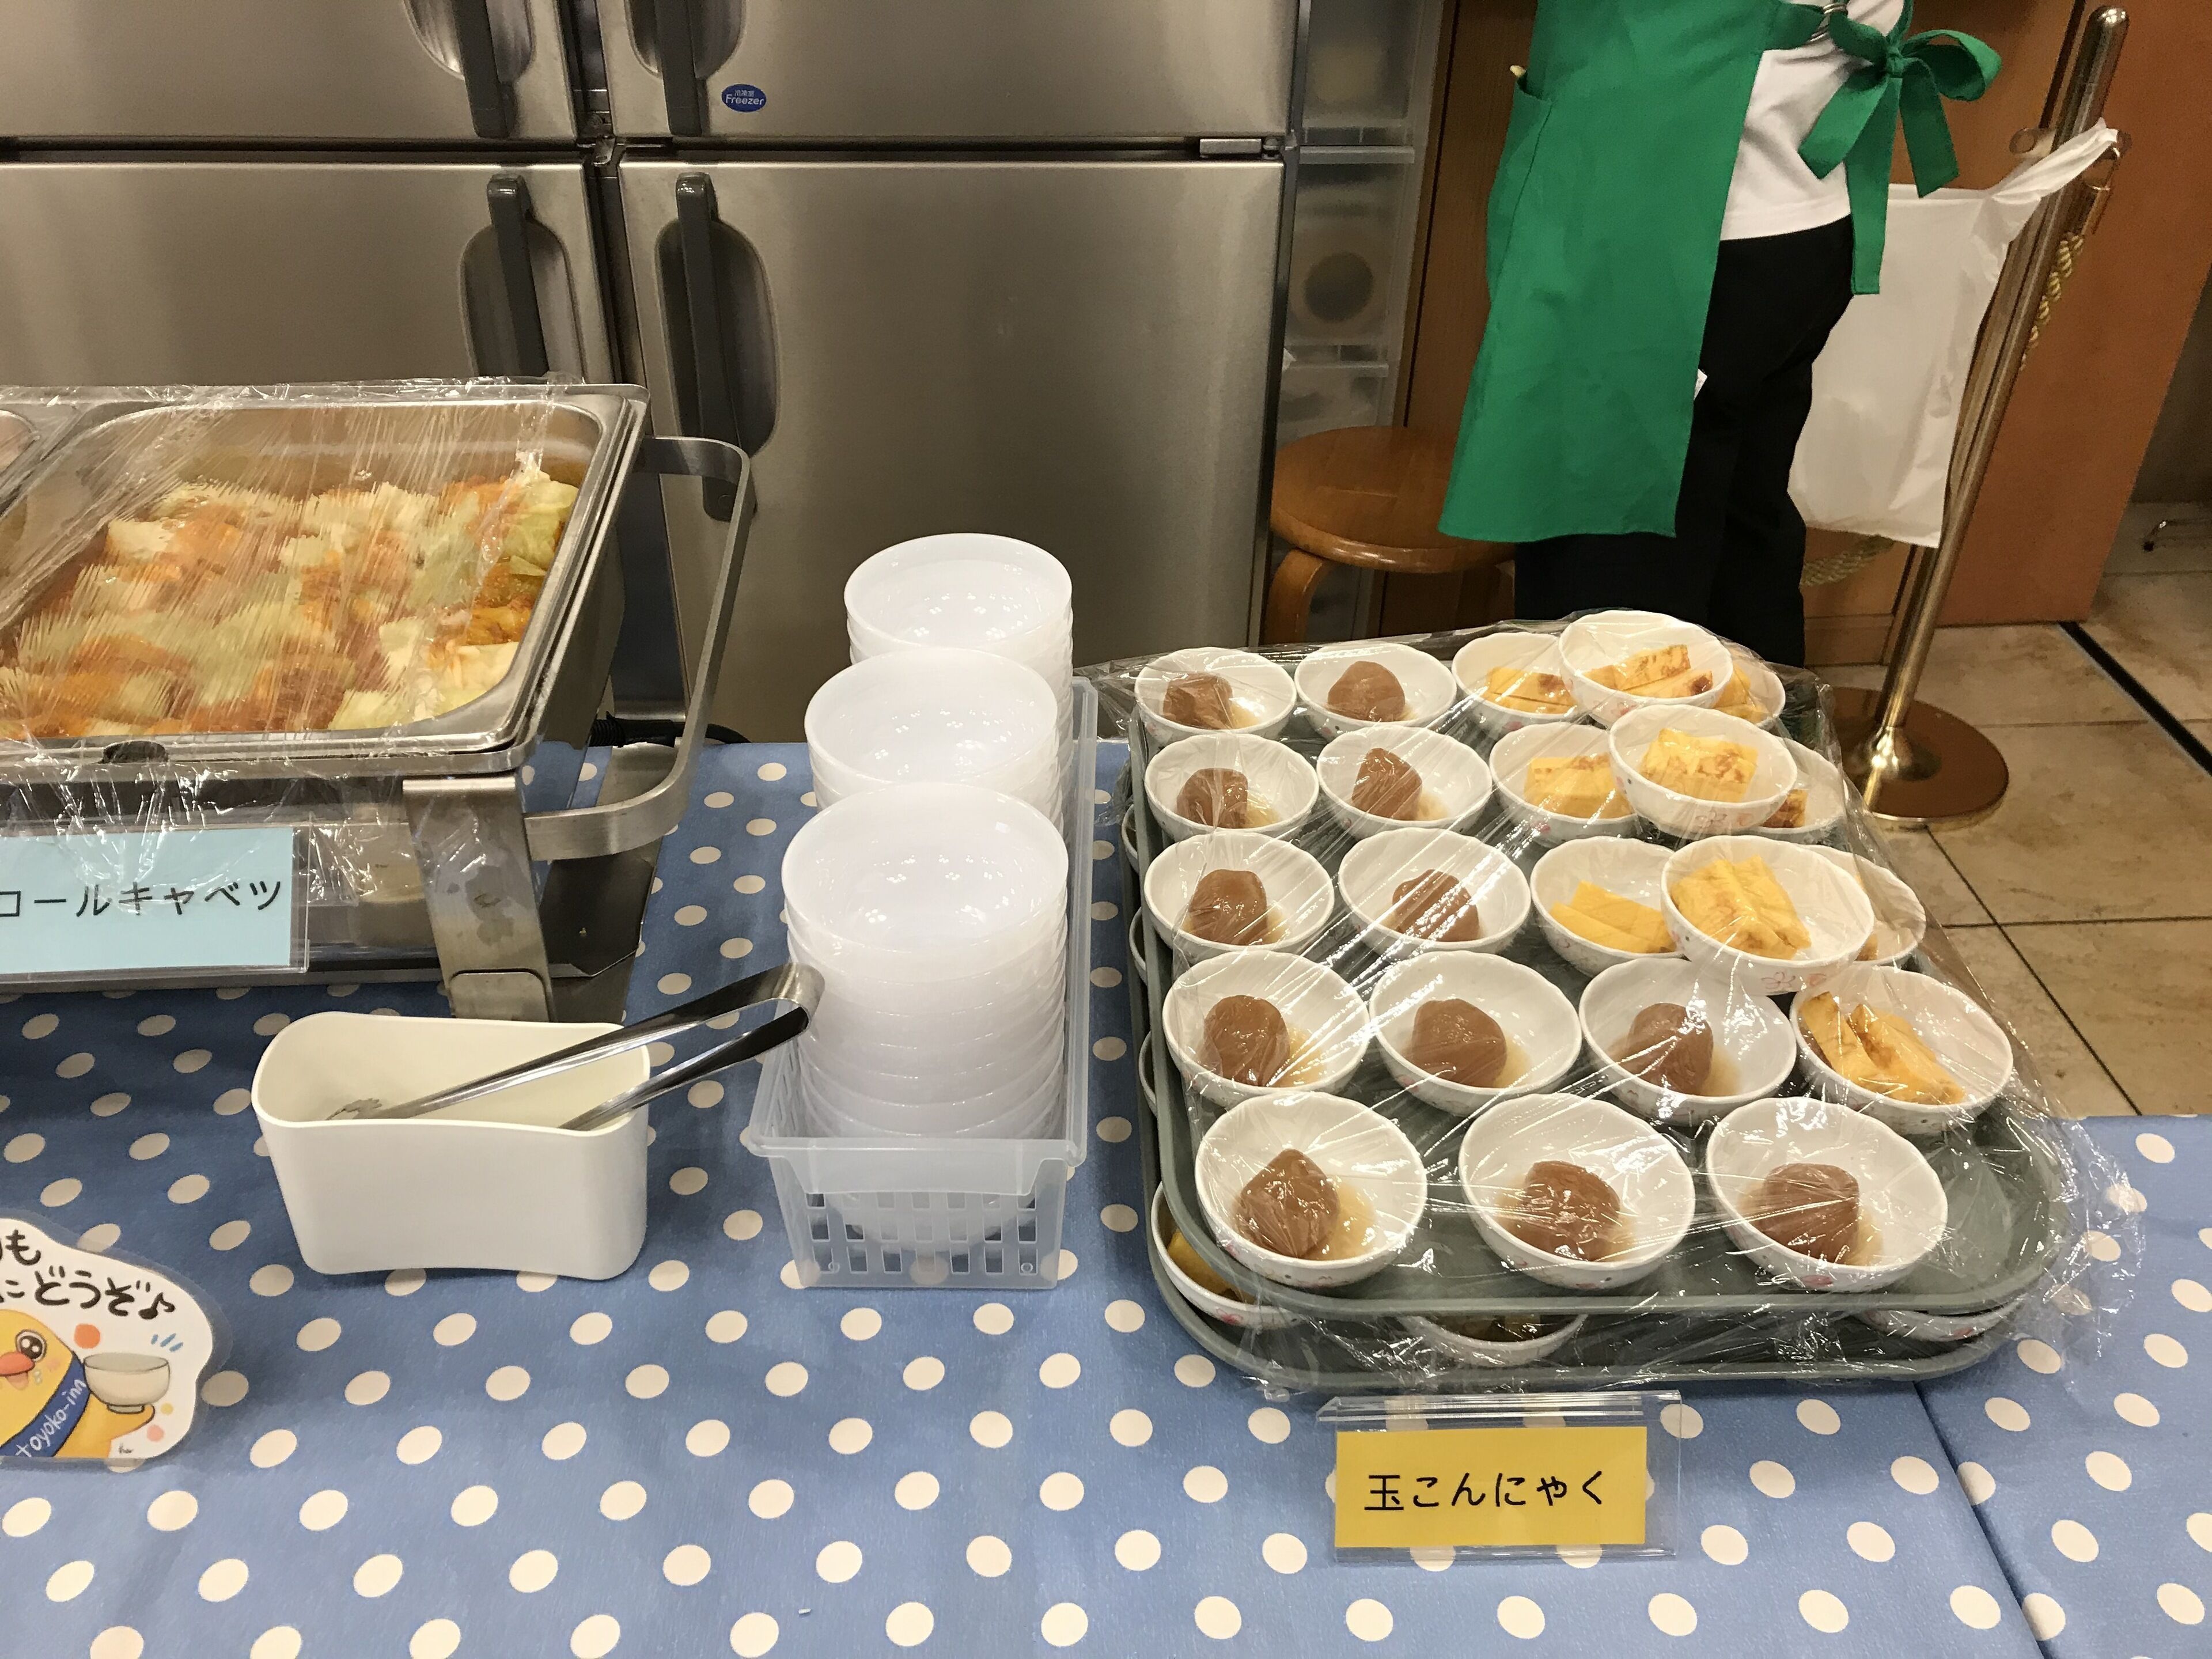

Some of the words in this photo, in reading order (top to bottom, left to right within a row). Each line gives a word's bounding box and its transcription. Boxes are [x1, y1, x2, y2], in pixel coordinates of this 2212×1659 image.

[725, 93, 764, 105] Freezer
[1363, 1470, 1603, 1511] 玉こんにゃく
